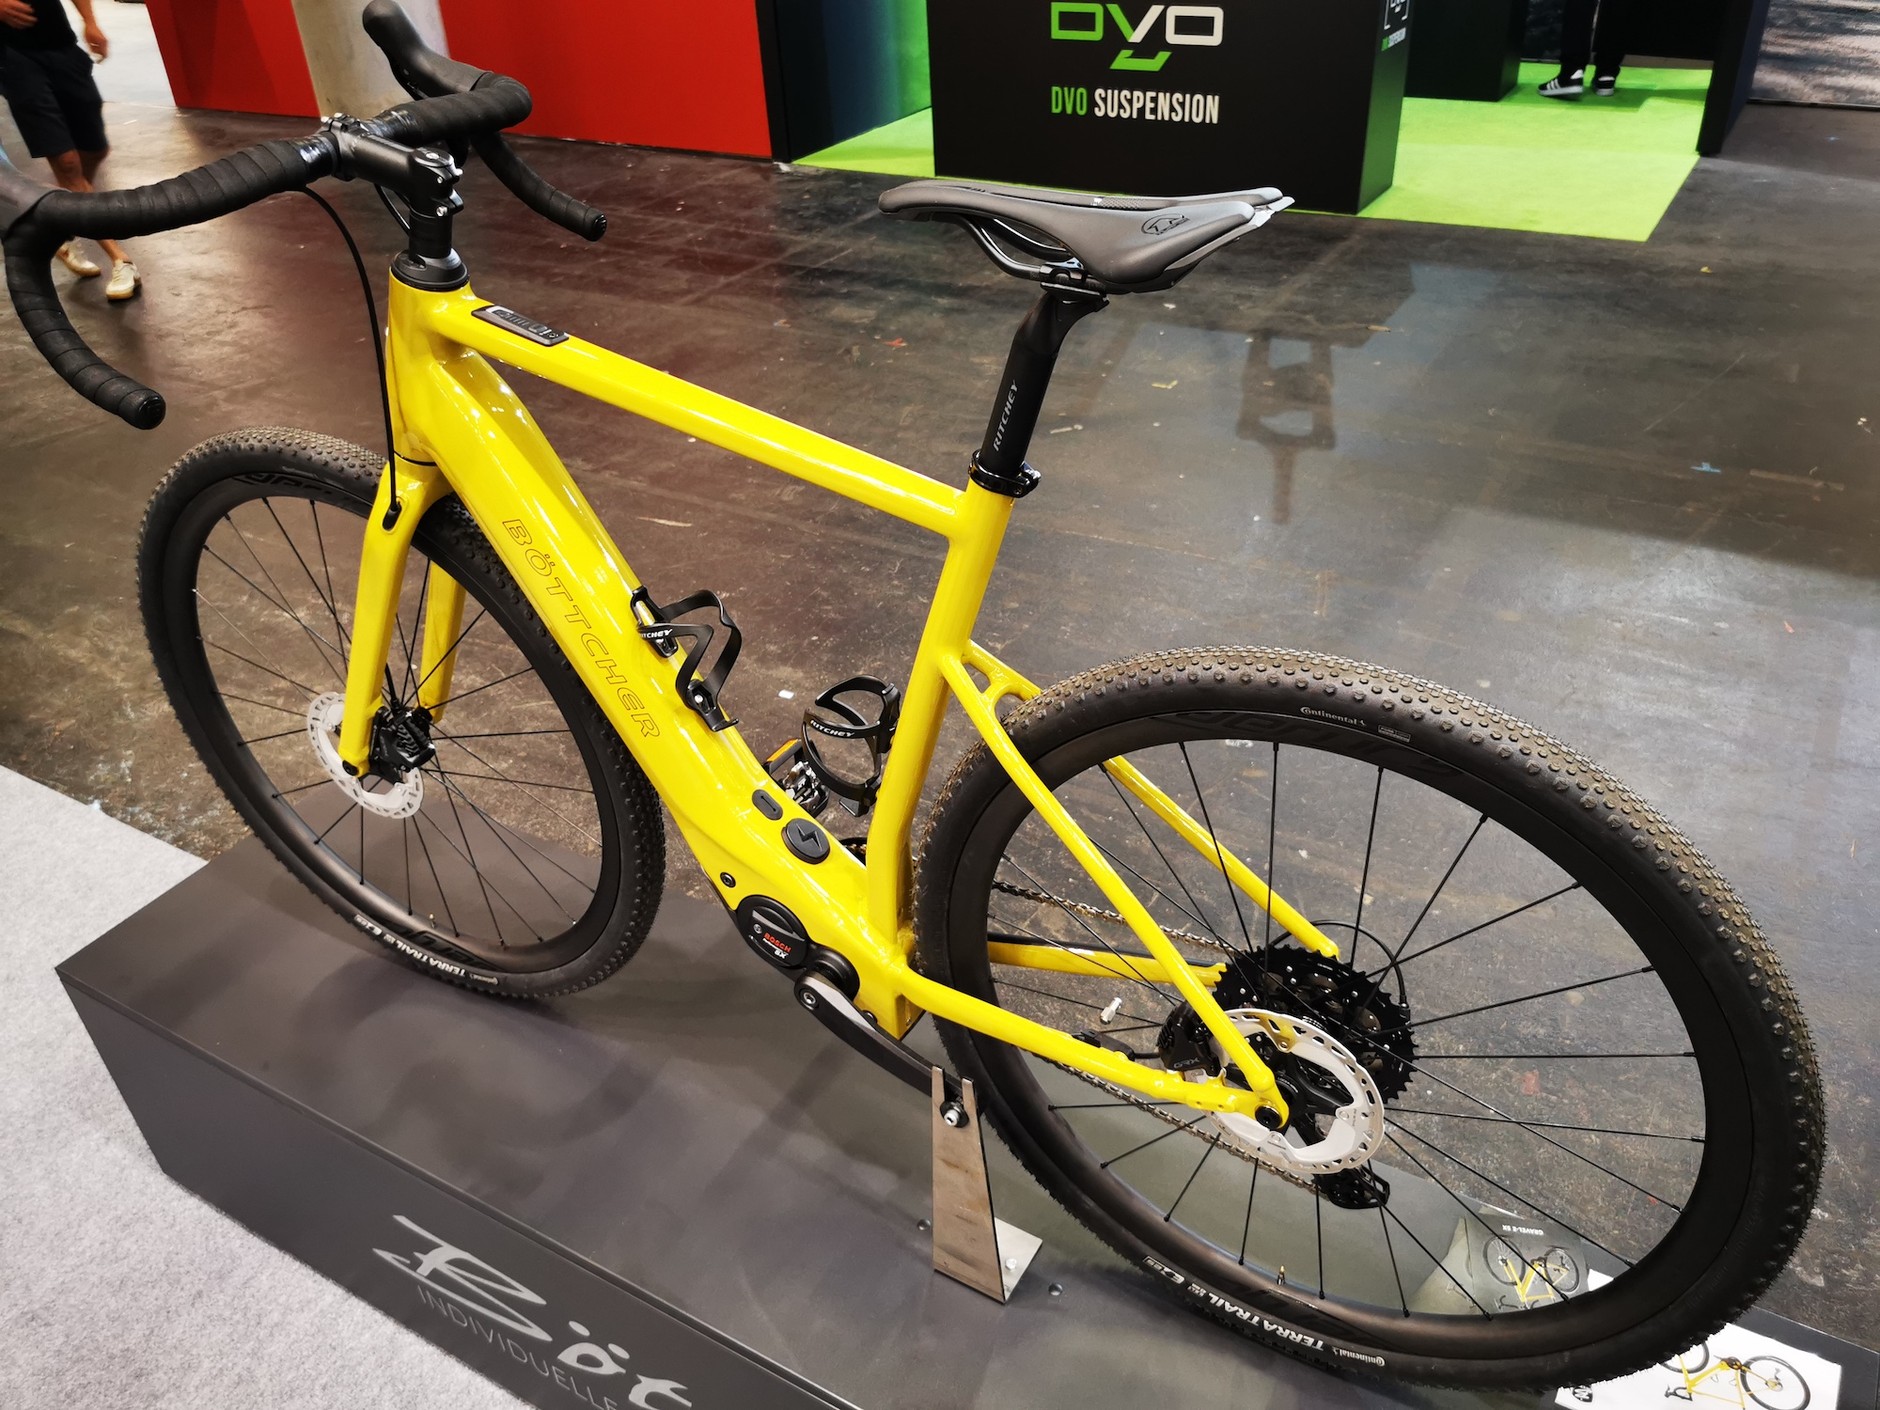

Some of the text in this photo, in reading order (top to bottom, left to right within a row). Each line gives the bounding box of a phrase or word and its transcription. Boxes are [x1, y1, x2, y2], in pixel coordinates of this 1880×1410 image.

[1051, 2, 1224, 46] DVO
[1050, 85, 1220, 125] DVO SUSPENSION
[993, 380, 1017, 451] RITCHEY
[502, 518, 661, 738] BÖTTCHER
[641, 628, 673, 639] ITCHEY
[809, 719, 856, 738] RITCHEY
[1301, 707, 1357, 724] Continental
[764, 932, 792, 952] BOSCH
[1208, 1293, 1261, 1324] TRAIL
[1262, 1319, 1324, 1352] TERRA
